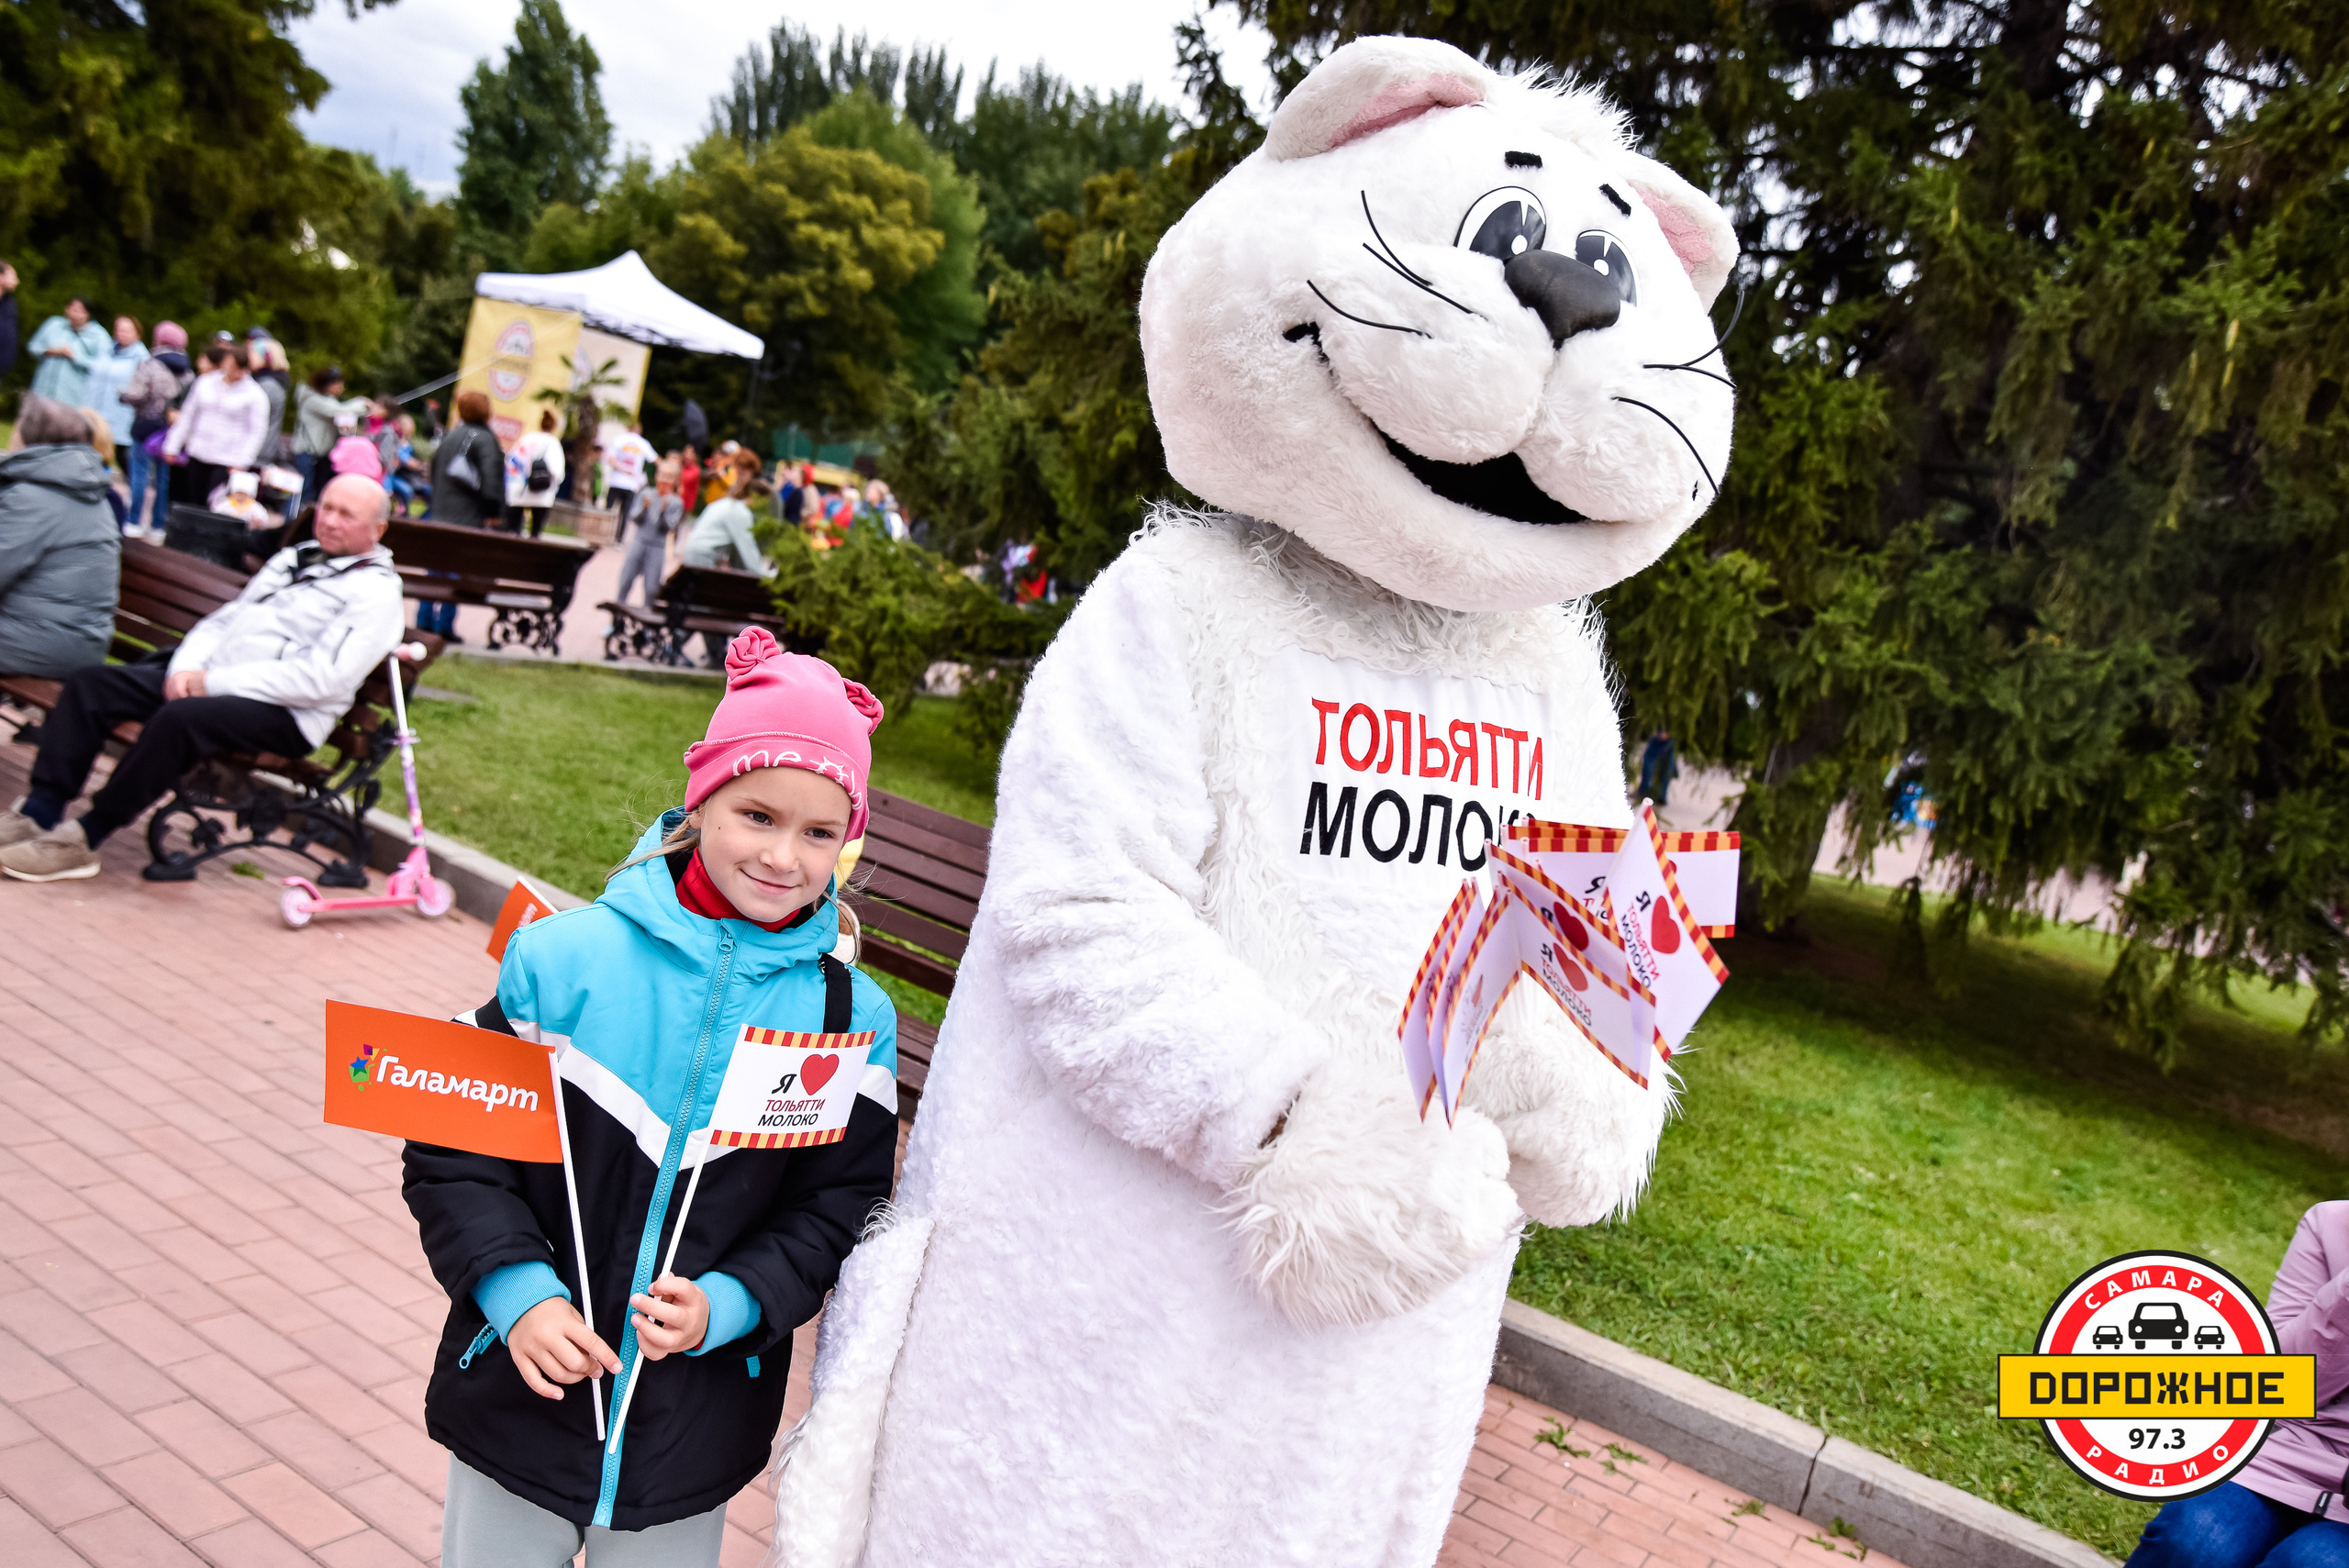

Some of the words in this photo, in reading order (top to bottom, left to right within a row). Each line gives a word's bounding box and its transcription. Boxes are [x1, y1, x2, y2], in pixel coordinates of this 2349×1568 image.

[1311, 696, 1543, 800] ТОЛЬЯТТИ
[1299, 781, 1536, 872] МОЛО
[1636, 891, 1652, 912] Я
[1541, 943, 1553, 962] Я
[1628, 902, 1661, 982] ТОЛЬЯТТИ
[375, 1055, 540, 1113] Галамарт
[771, 1073, 797, 1095] Я
[765, 1098, 826, 1112] ТОЛЬЯТТИ
[758, 1113, 818, 1128] МОЛОКО
